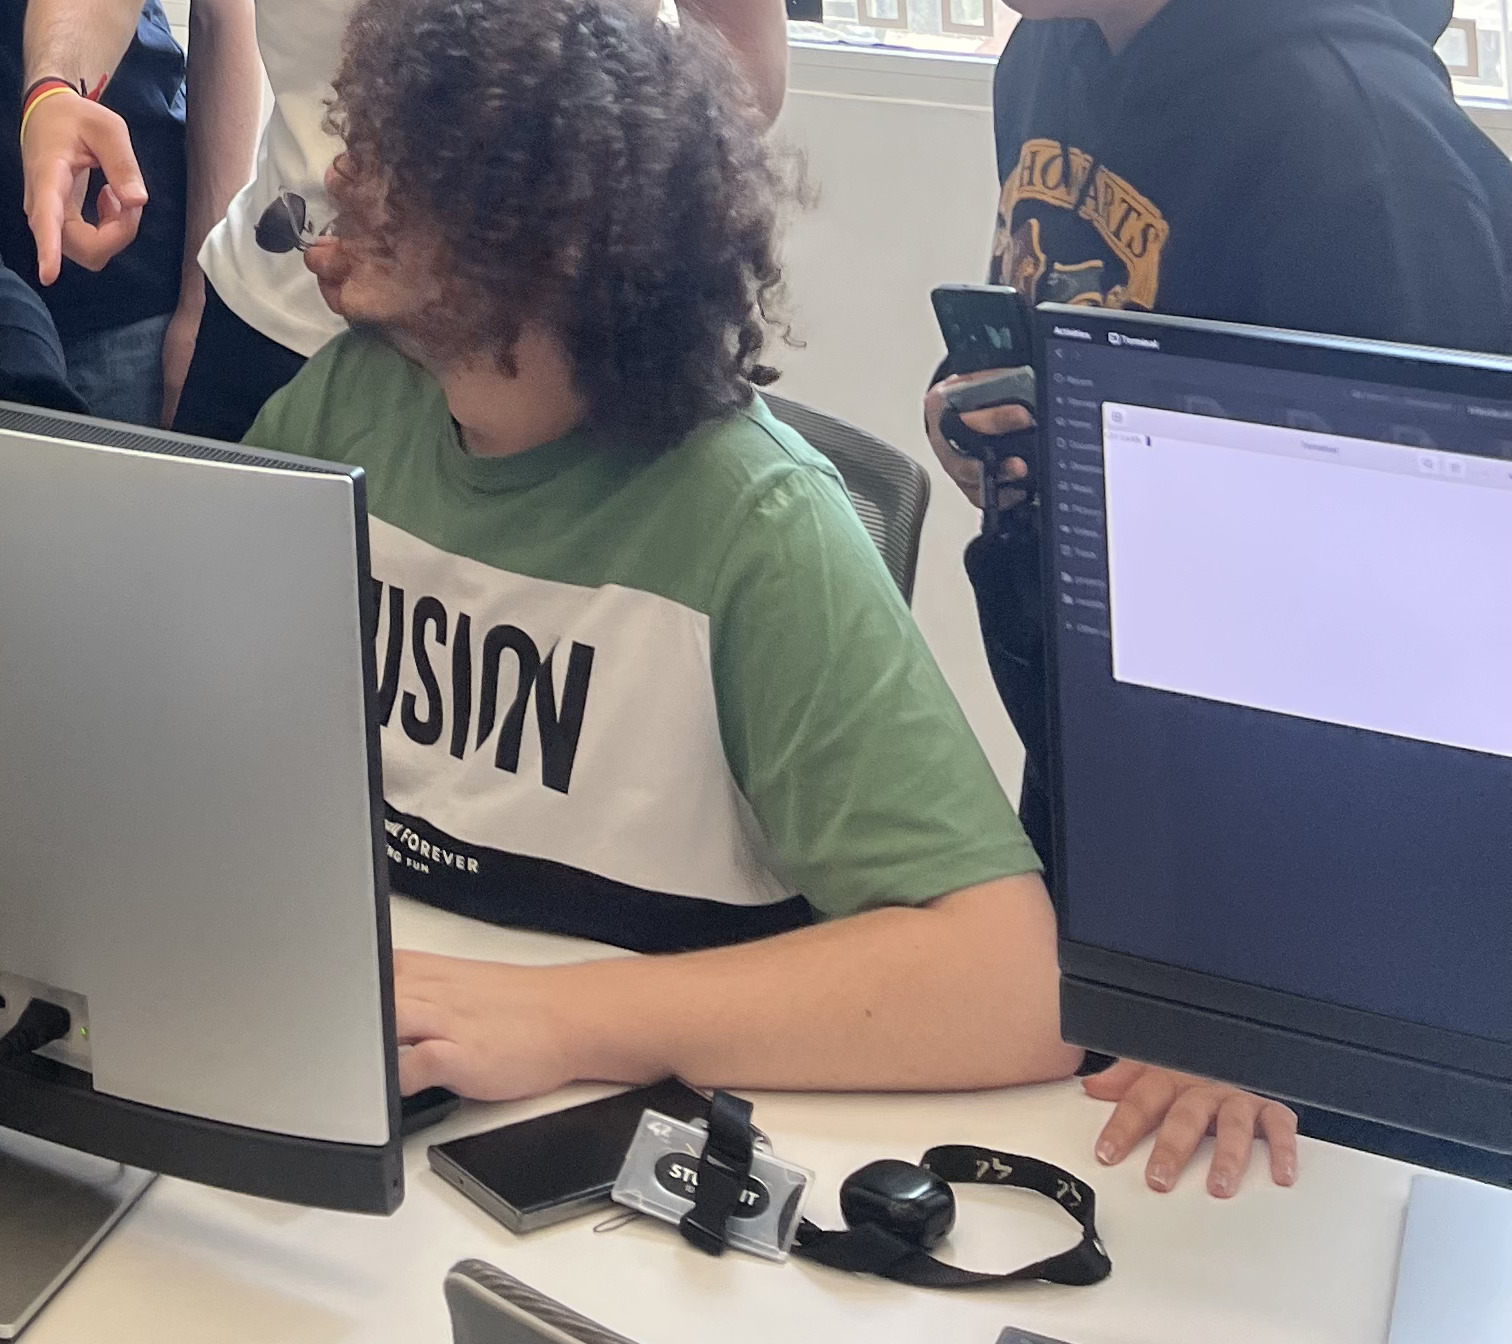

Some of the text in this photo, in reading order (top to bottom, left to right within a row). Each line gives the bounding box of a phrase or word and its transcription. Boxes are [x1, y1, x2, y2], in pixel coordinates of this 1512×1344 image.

[370, 577, 595, 795] USION
[400, 828, 479, 874] FOREVER
[406, 857, 429, 874] FUN
